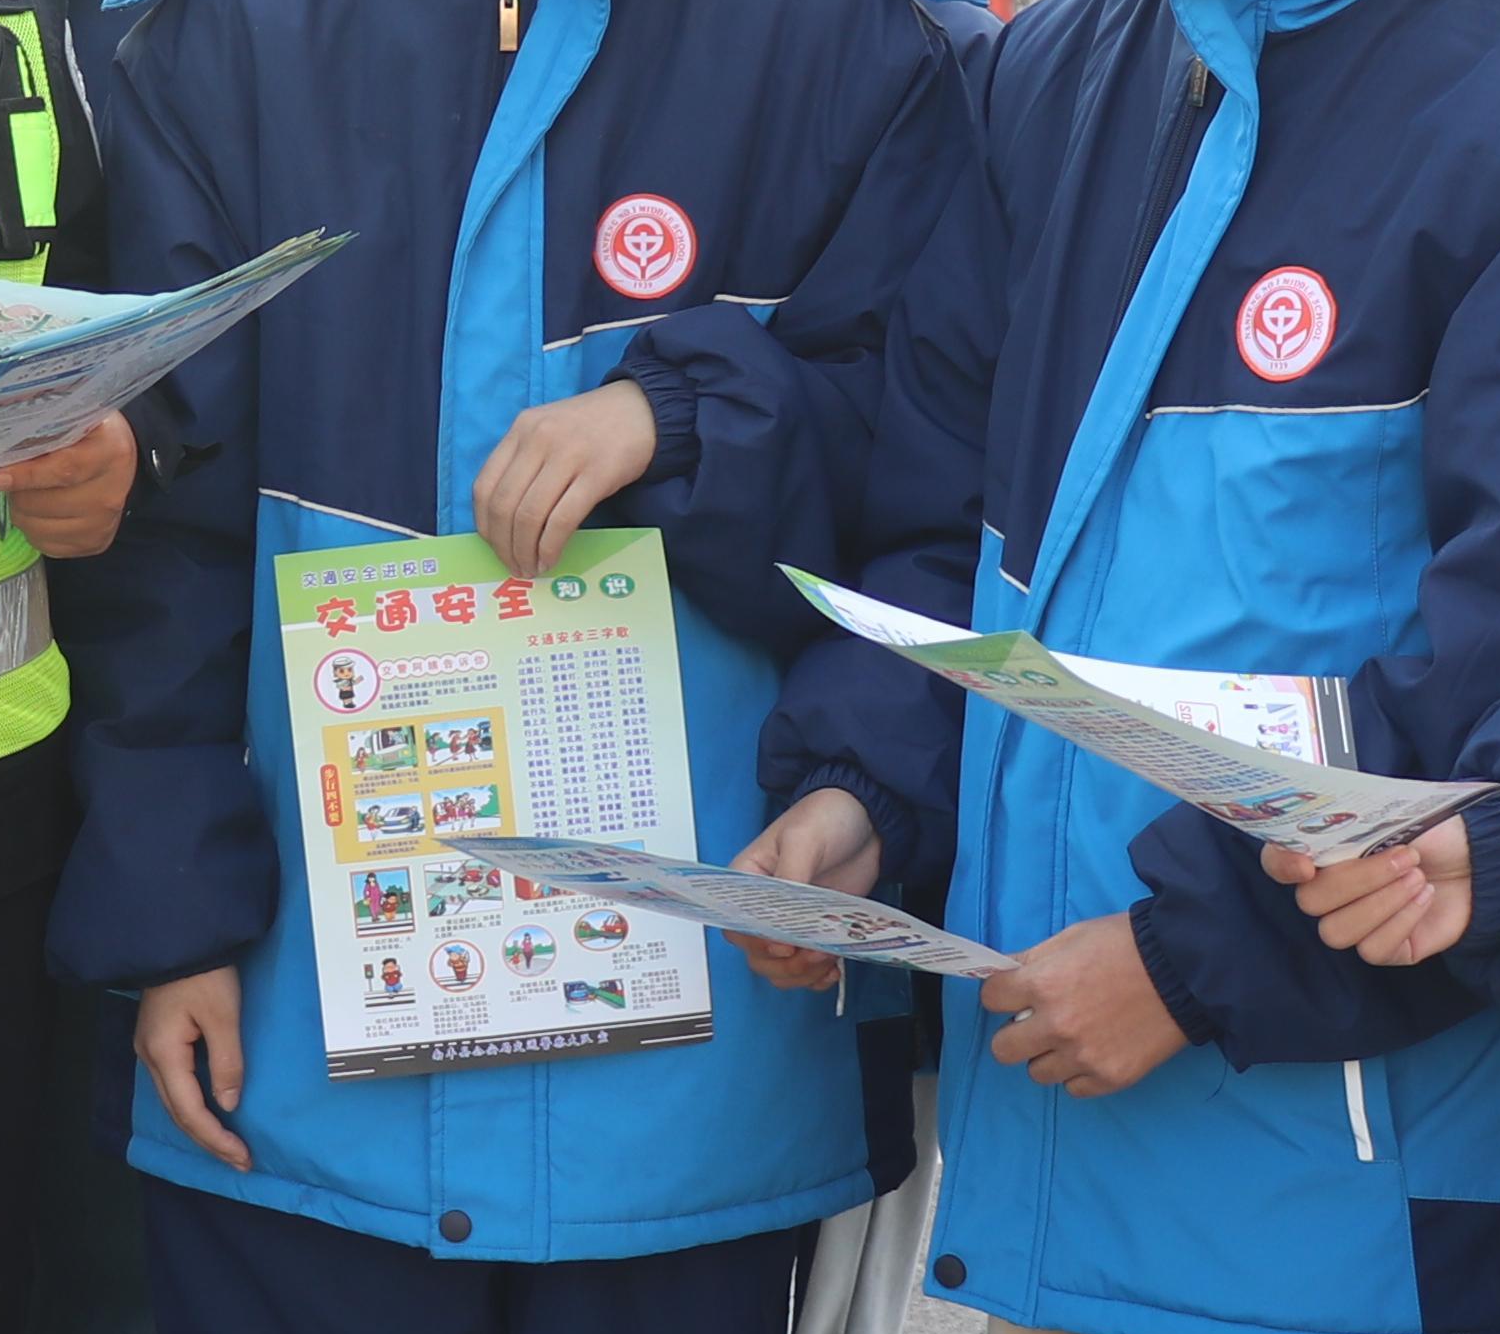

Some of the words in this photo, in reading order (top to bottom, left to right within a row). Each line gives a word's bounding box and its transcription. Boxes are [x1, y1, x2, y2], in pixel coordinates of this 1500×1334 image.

[302, 559, 438, 588] 交通安全进校园
[526, 626, 630, 647] 交通安全三字歌
